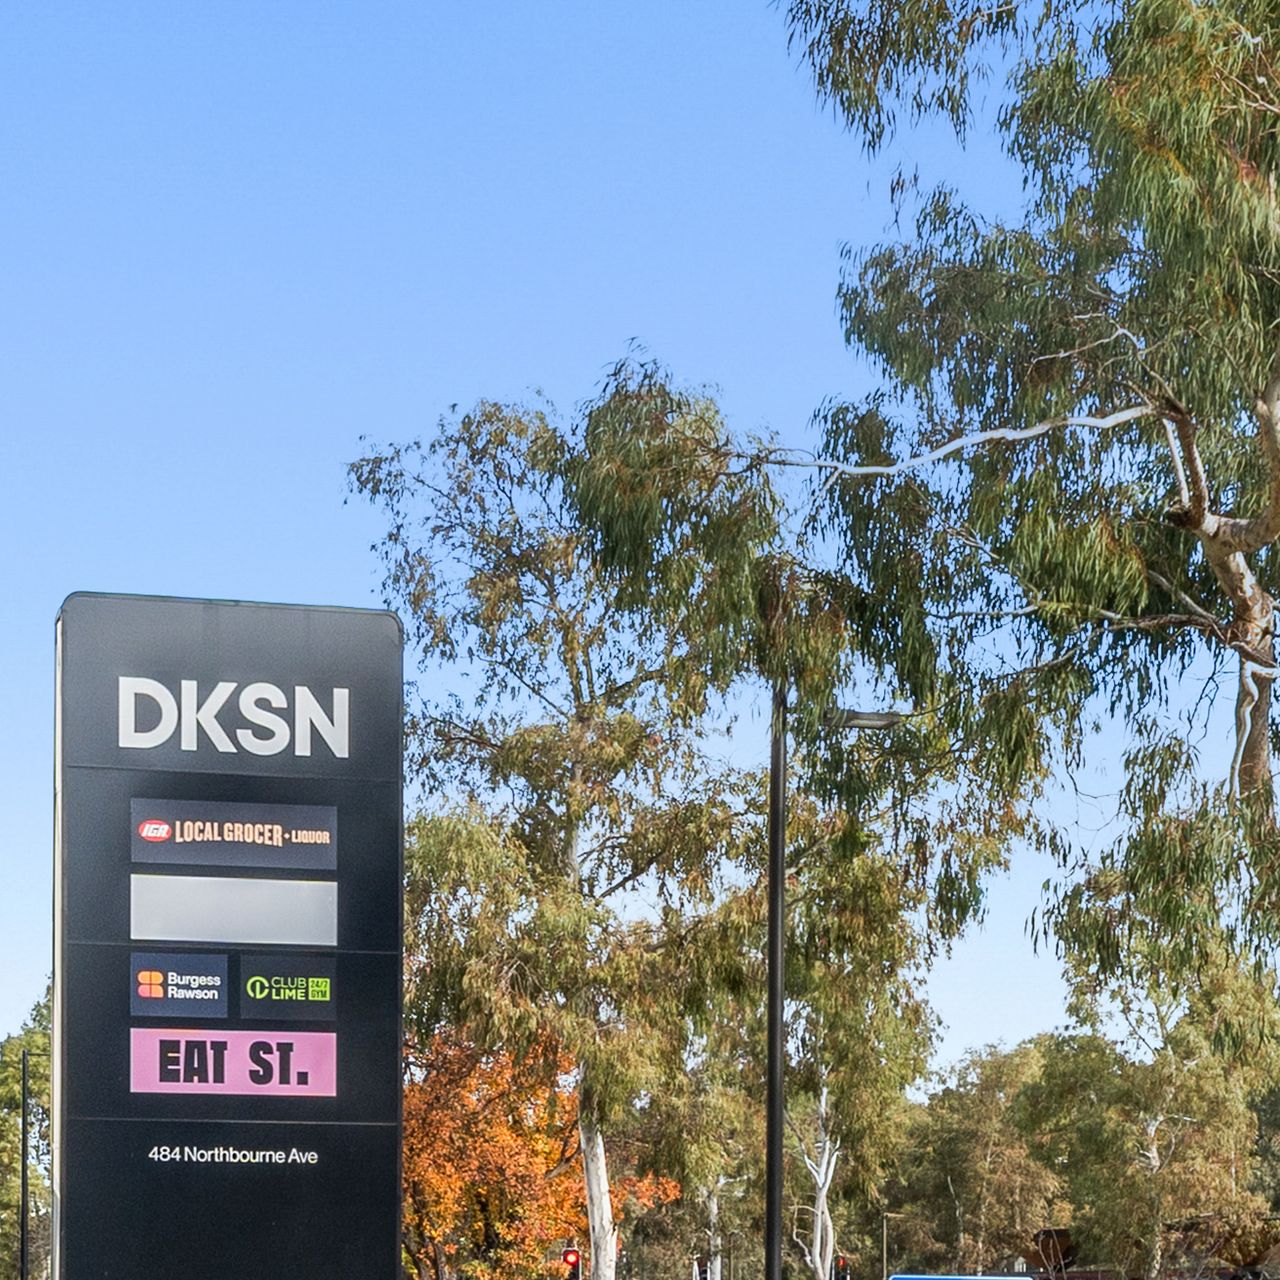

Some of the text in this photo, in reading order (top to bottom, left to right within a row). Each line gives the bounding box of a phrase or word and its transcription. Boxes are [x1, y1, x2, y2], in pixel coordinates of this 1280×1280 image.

[118, 676, 349, 758] DKSN
[140, 823, 170, 838] IGA
[175, 820, 222, 843] LOCAL
[223, 822, 283, 847] GROCER
[291, 829, 331, 844] LIQUOR
[167, 972, 221, 986] Burgess
[271, 976, 307, 988] CLUB
[310, 979, 329, 989] 24/7
[167, 986, 219, 1000] Rawson
[272, 989, 306, 1000] LIME
[310, 989, 328, 999] GYM
[159, 1039, 309, 1086] EAT ST.
[148, 1146, 319, 1163] 484 Northbourne Ave
